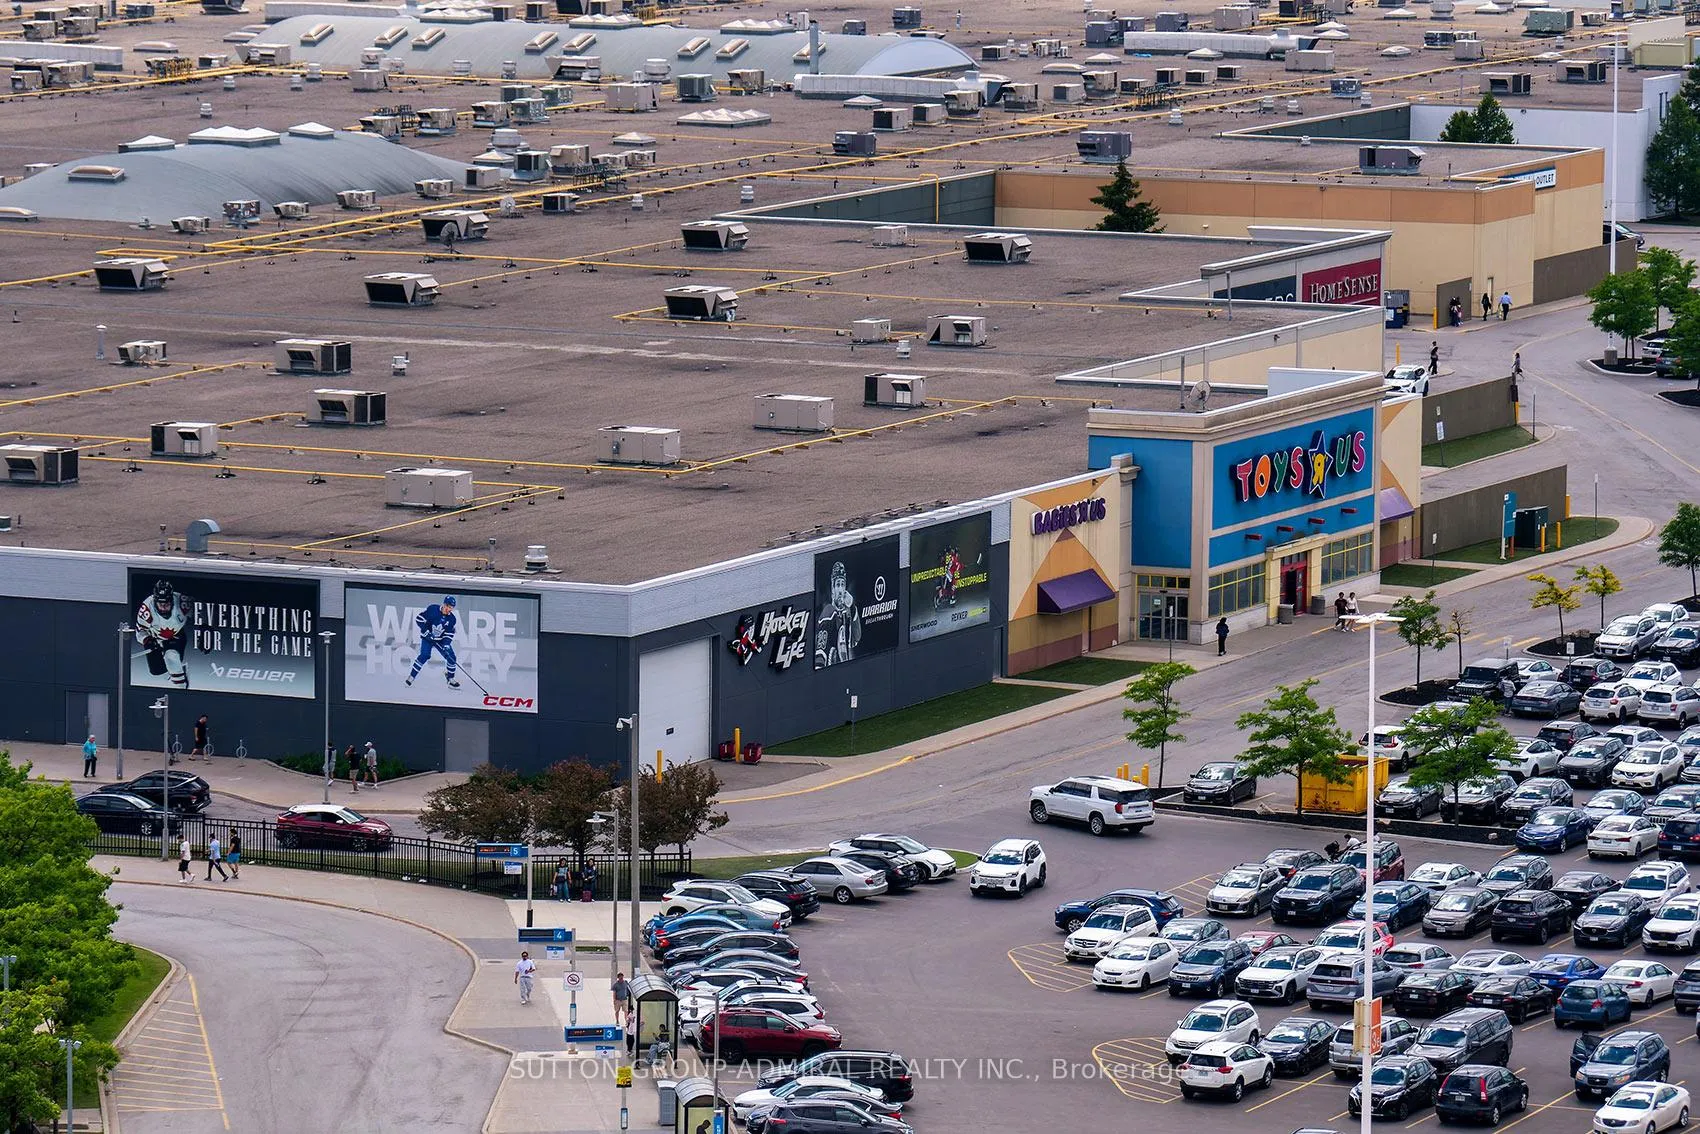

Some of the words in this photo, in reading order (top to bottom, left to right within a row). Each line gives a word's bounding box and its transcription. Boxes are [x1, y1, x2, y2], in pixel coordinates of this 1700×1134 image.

[1236, 446, 1304, 502] TOYS
[1336, 430, 1366, 478] US
[862, 600, 898, 618] WARRIOR
[193, 602, 312, 634] EVERYTHING
[193, 629, 222, 651] FOR
[231, 632, 261, 654] THE
[271, 634, 312, 657] GAME
[366, 643, 517, 683] HOEY
[227, 667, 297, 682] BAUER
[483, 696, 533, 708] CCM
[513, 847, 518, 855] 5
[556, 931, 562, 939] 4
[606, 1030, 612, 1038] 3
